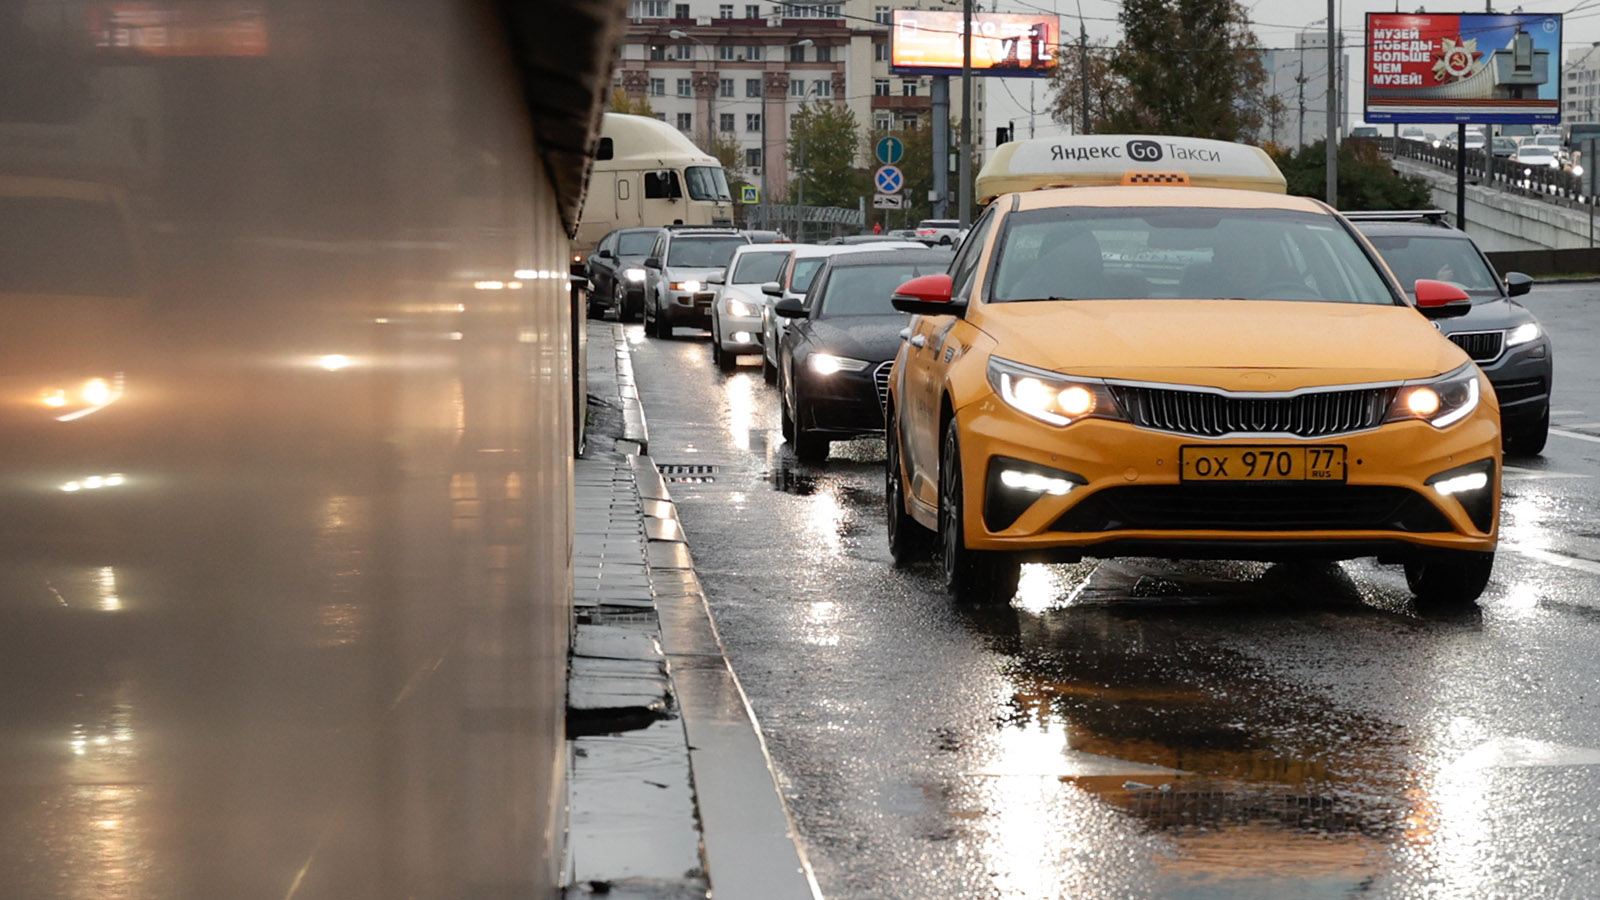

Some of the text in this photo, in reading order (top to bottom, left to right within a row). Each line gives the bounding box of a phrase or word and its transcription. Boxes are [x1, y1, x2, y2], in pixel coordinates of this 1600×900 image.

[1373, 27, 1419, 39] МУЗЕЙ
[1373, 51, 1431, 63] БОЛЬШЕ
[1373, 63, 1402, 73] ЧЕМ
[1373, 73, 1423, 85] МУЗЕЙ!
[1051, 141, 1221, 163] Яндекс Go Такси
[1242, 451, 1292, 477] 970
[1308, 450, 1335, 469] 77
[1312, 470, 1332, 478] RUS
